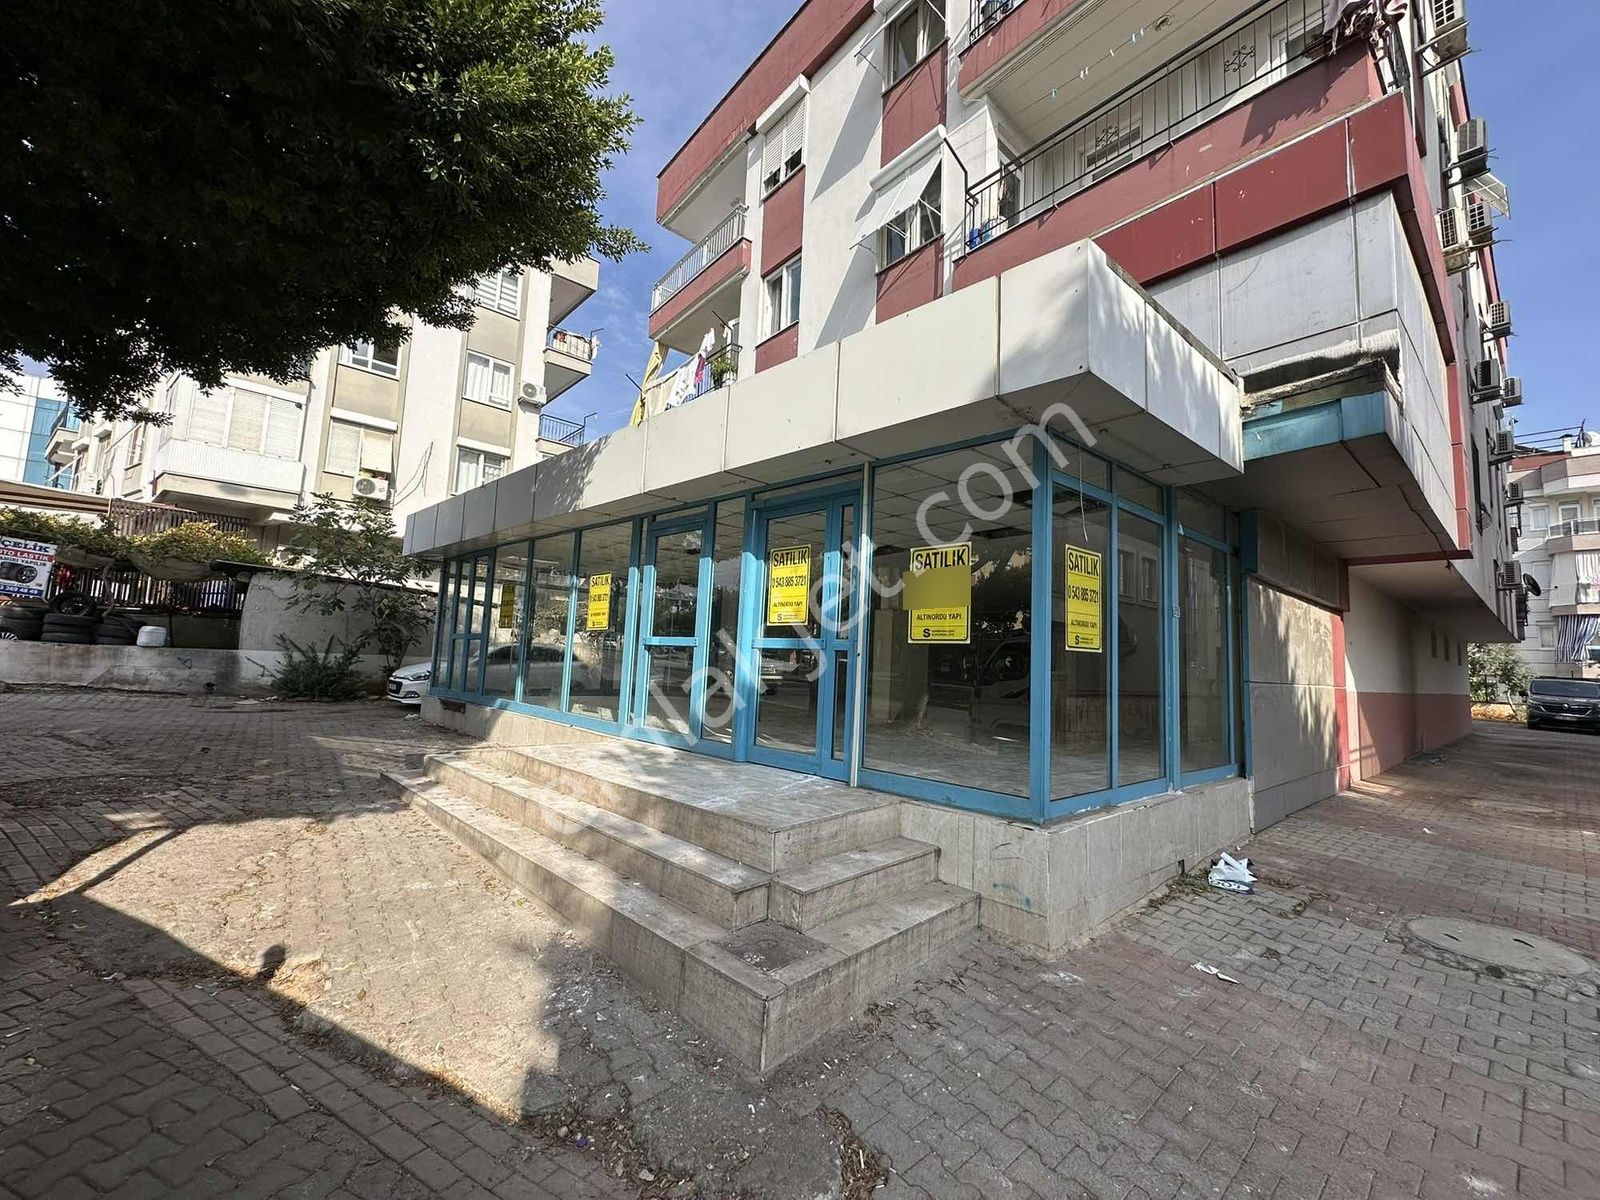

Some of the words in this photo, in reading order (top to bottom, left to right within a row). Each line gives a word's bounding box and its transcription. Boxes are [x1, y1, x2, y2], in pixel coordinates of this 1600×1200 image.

[773, 550, 807, 567] SATILIK
[915, 548, 966, 570] SATILIK
[1068, 552, 1099, 577] SATILIK
[917, 613, 947, 621] ALTINORDU
[923, 628, 931, 638] S
